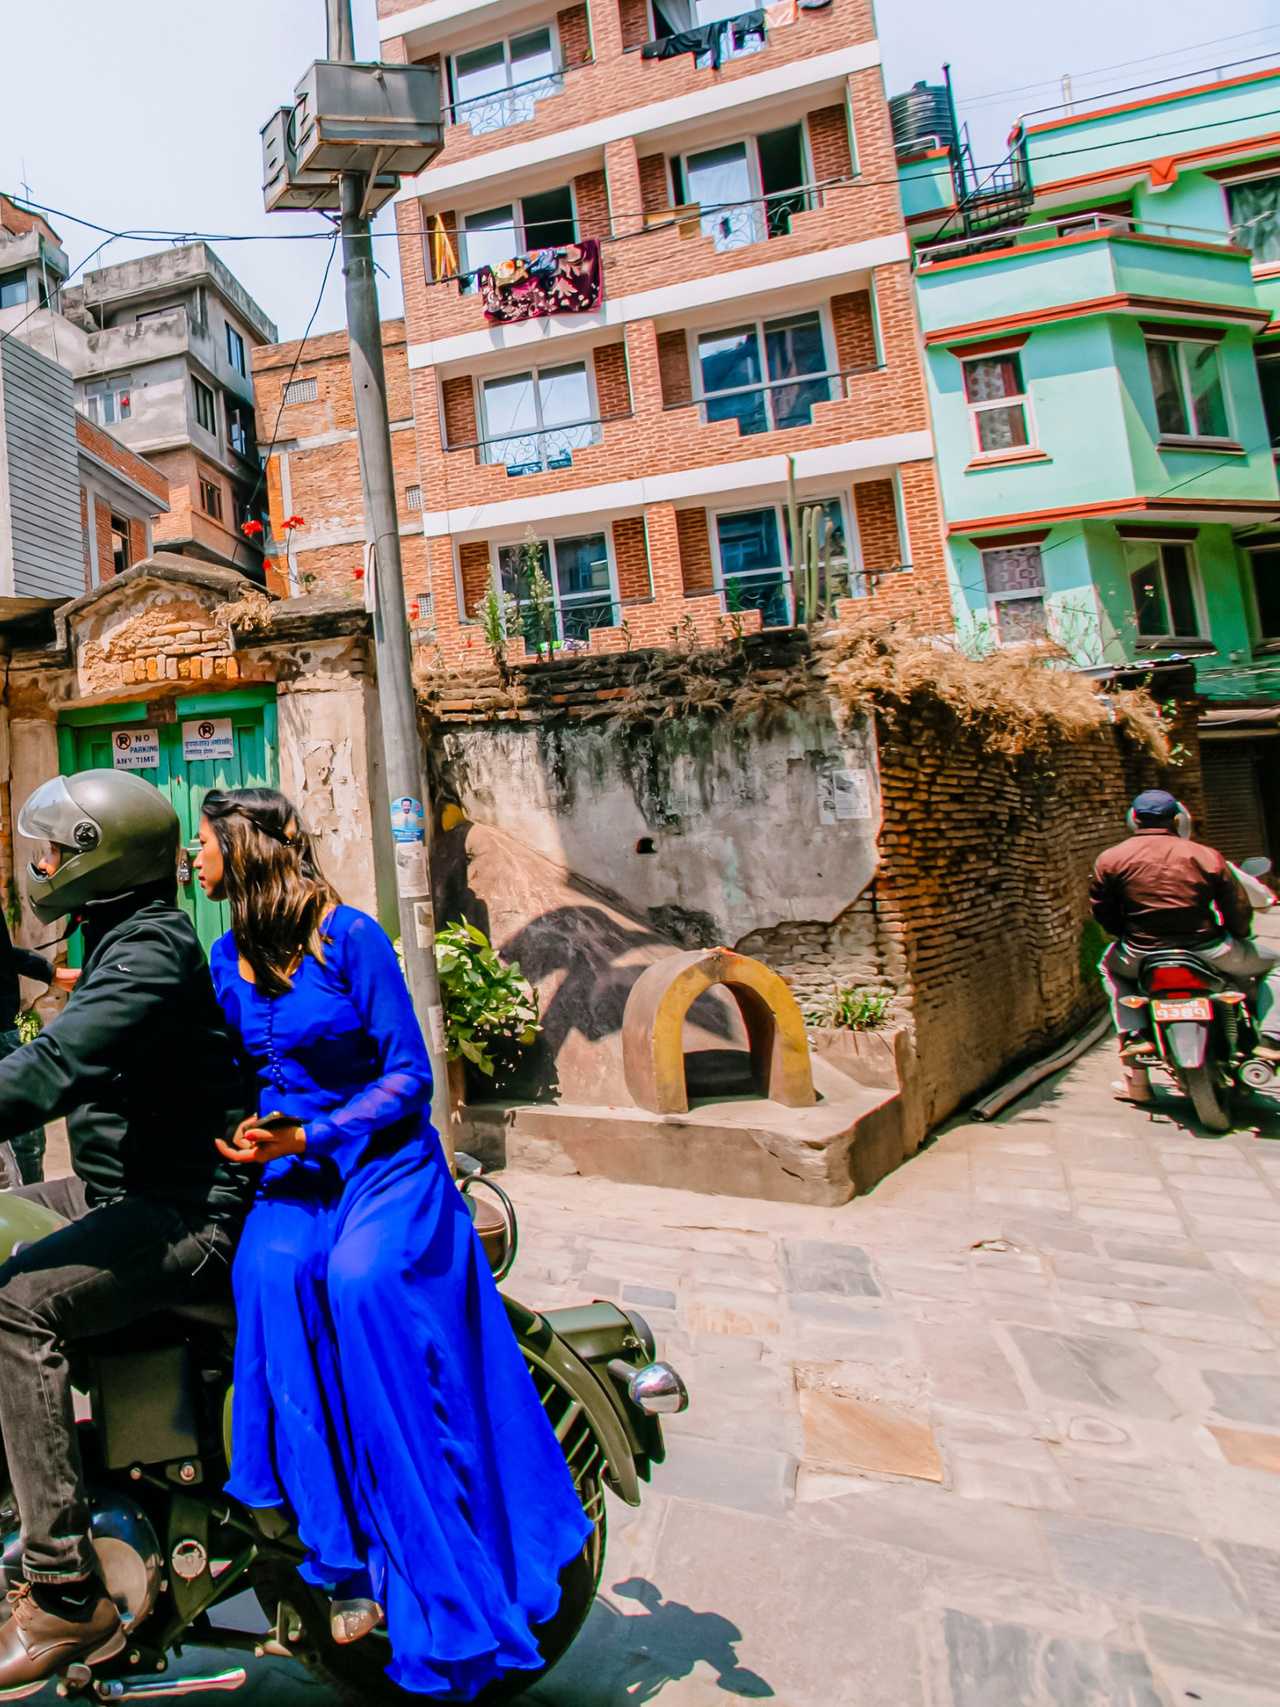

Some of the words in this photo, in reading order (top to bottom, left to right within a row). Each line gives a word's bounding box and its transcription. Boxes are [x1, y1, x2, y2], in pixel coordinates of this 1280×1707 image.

[135, 734, 150, 743] NO
[130, 745, 158, 753] PARKING
[116, 757, 133, 765] ANY
[135, 755, 155, 764] TIME
